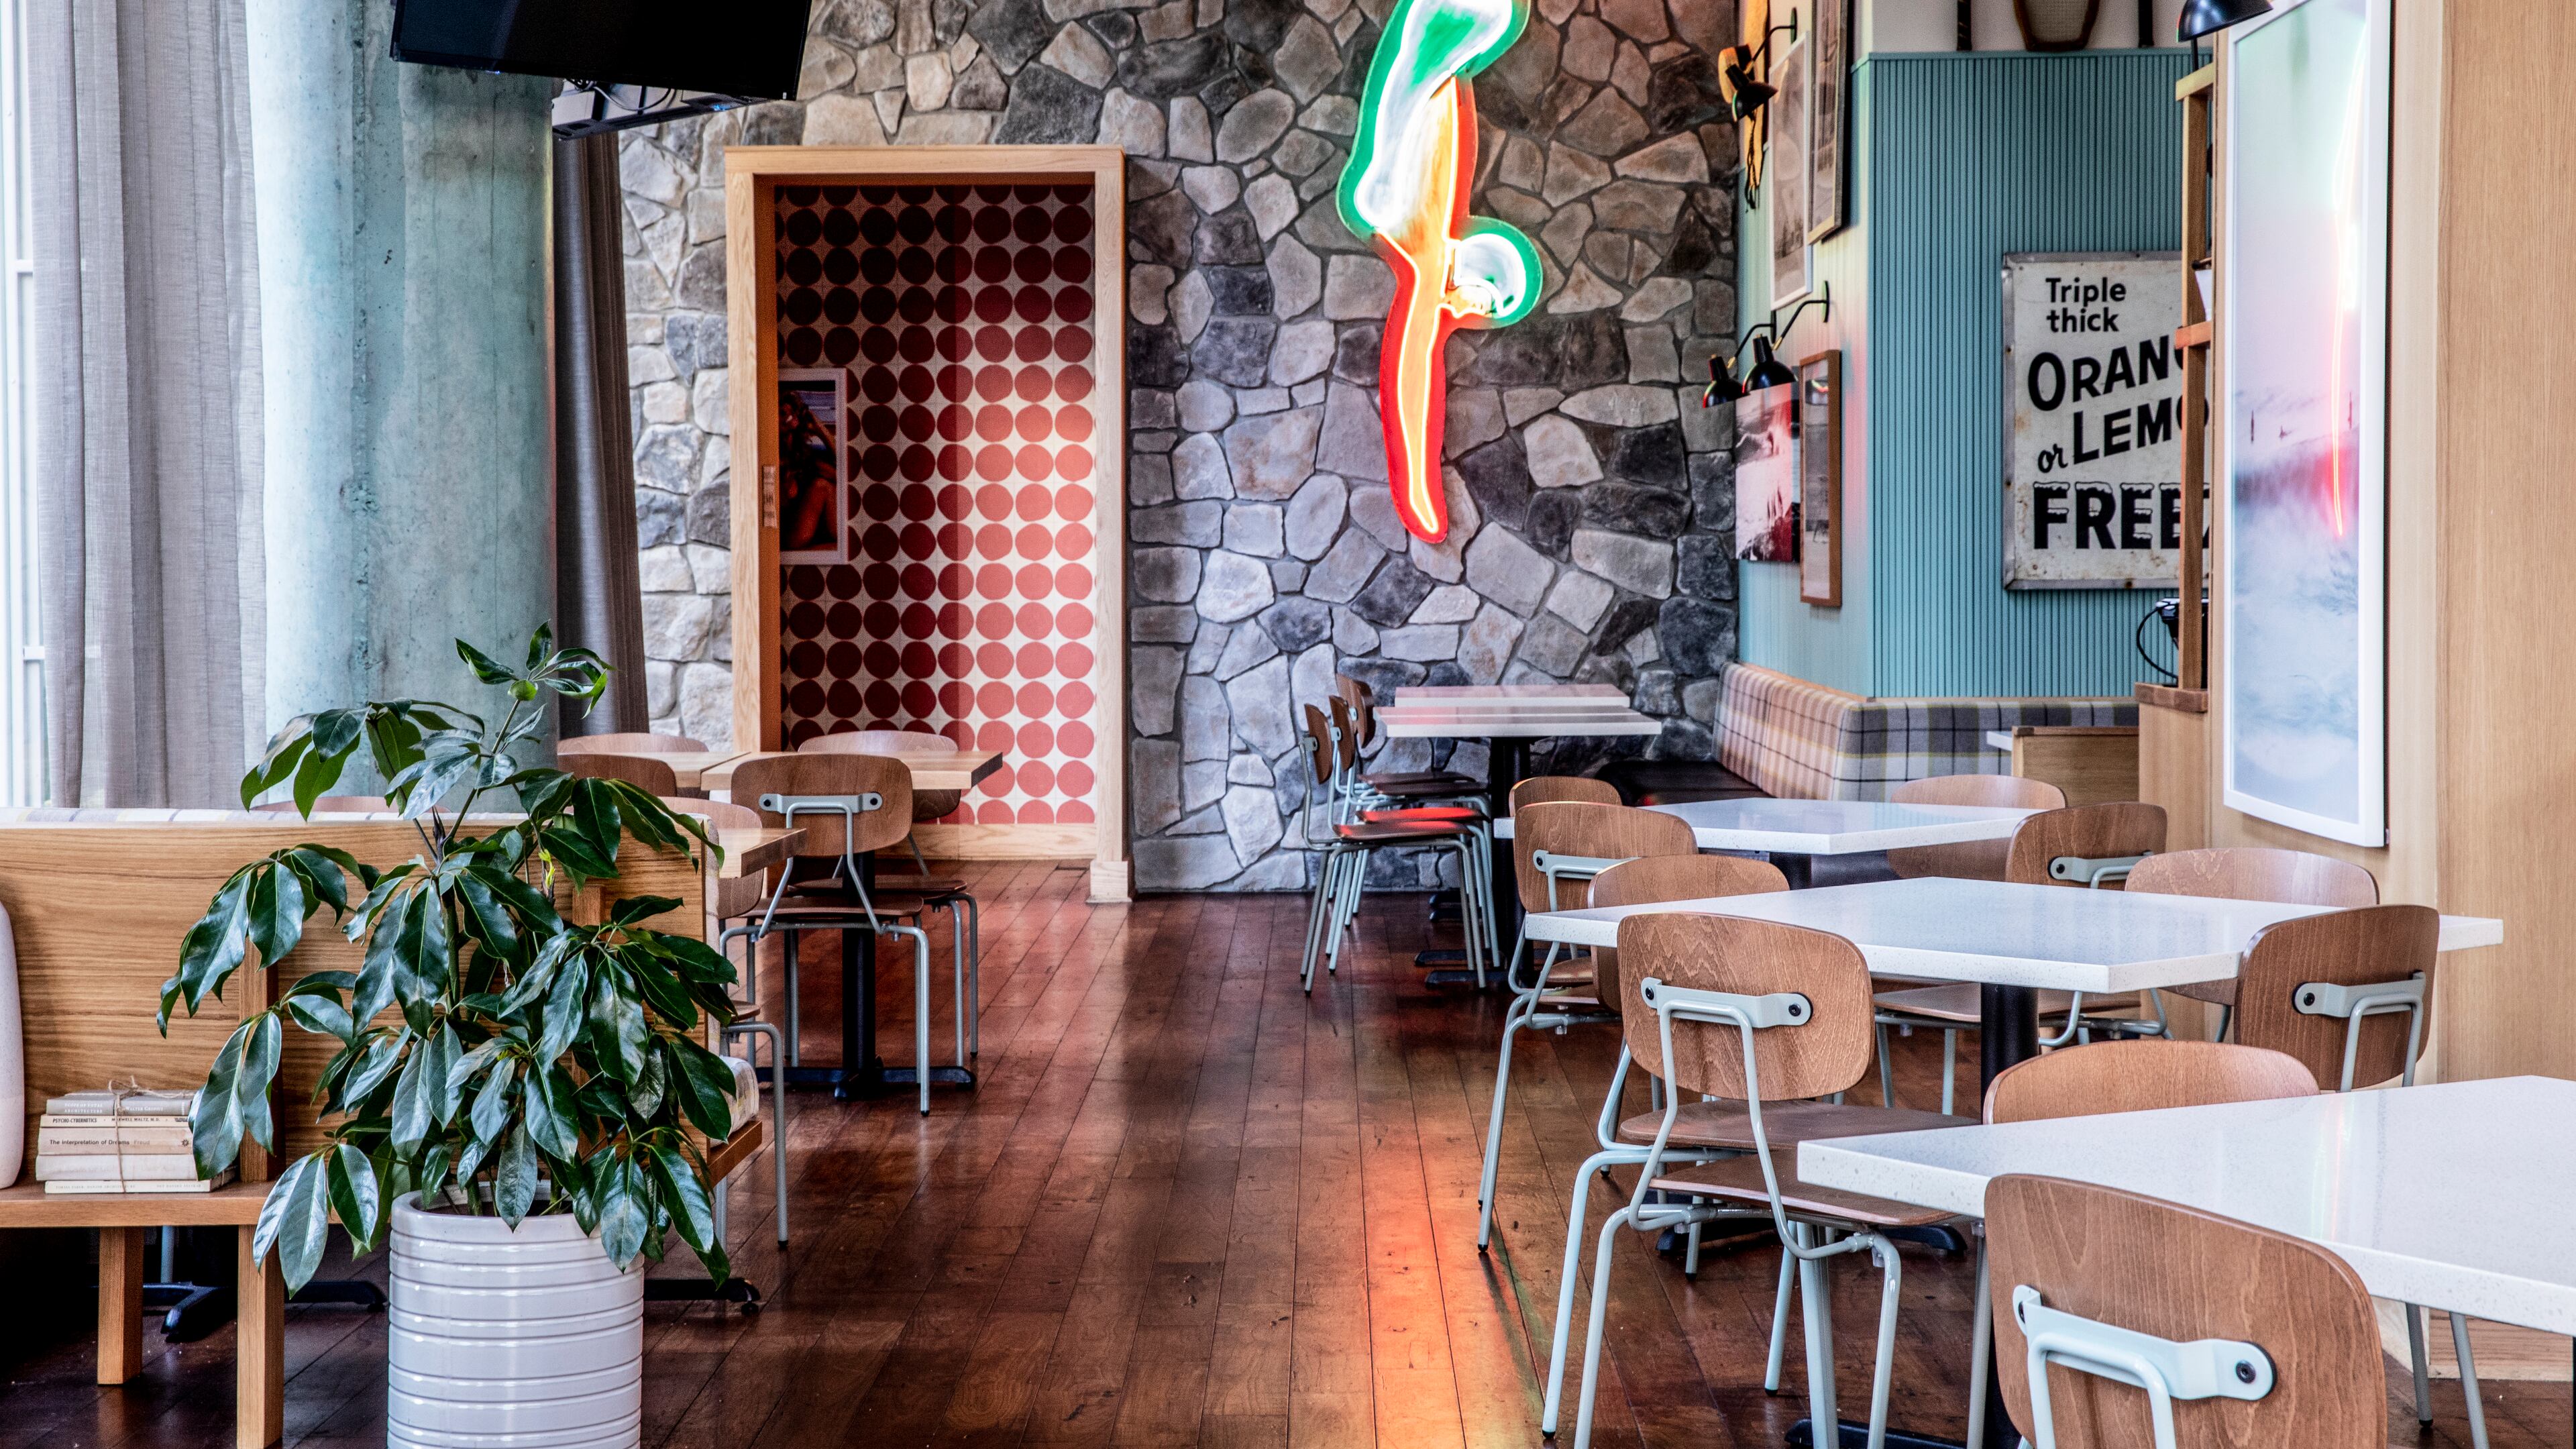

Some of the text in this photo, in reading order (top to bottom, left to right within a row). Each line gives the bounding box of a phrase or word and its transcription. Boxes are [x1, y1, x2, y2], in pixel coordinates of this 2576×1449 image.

[2045, 277, 2127, 306] Triple
[2046, 307, 2120, 333] thick
[2027, 335, 2183, 412] ORAN
[2037, 394, 2209, 473] or LEM
[2033, 481, 2210, 549] FREE
